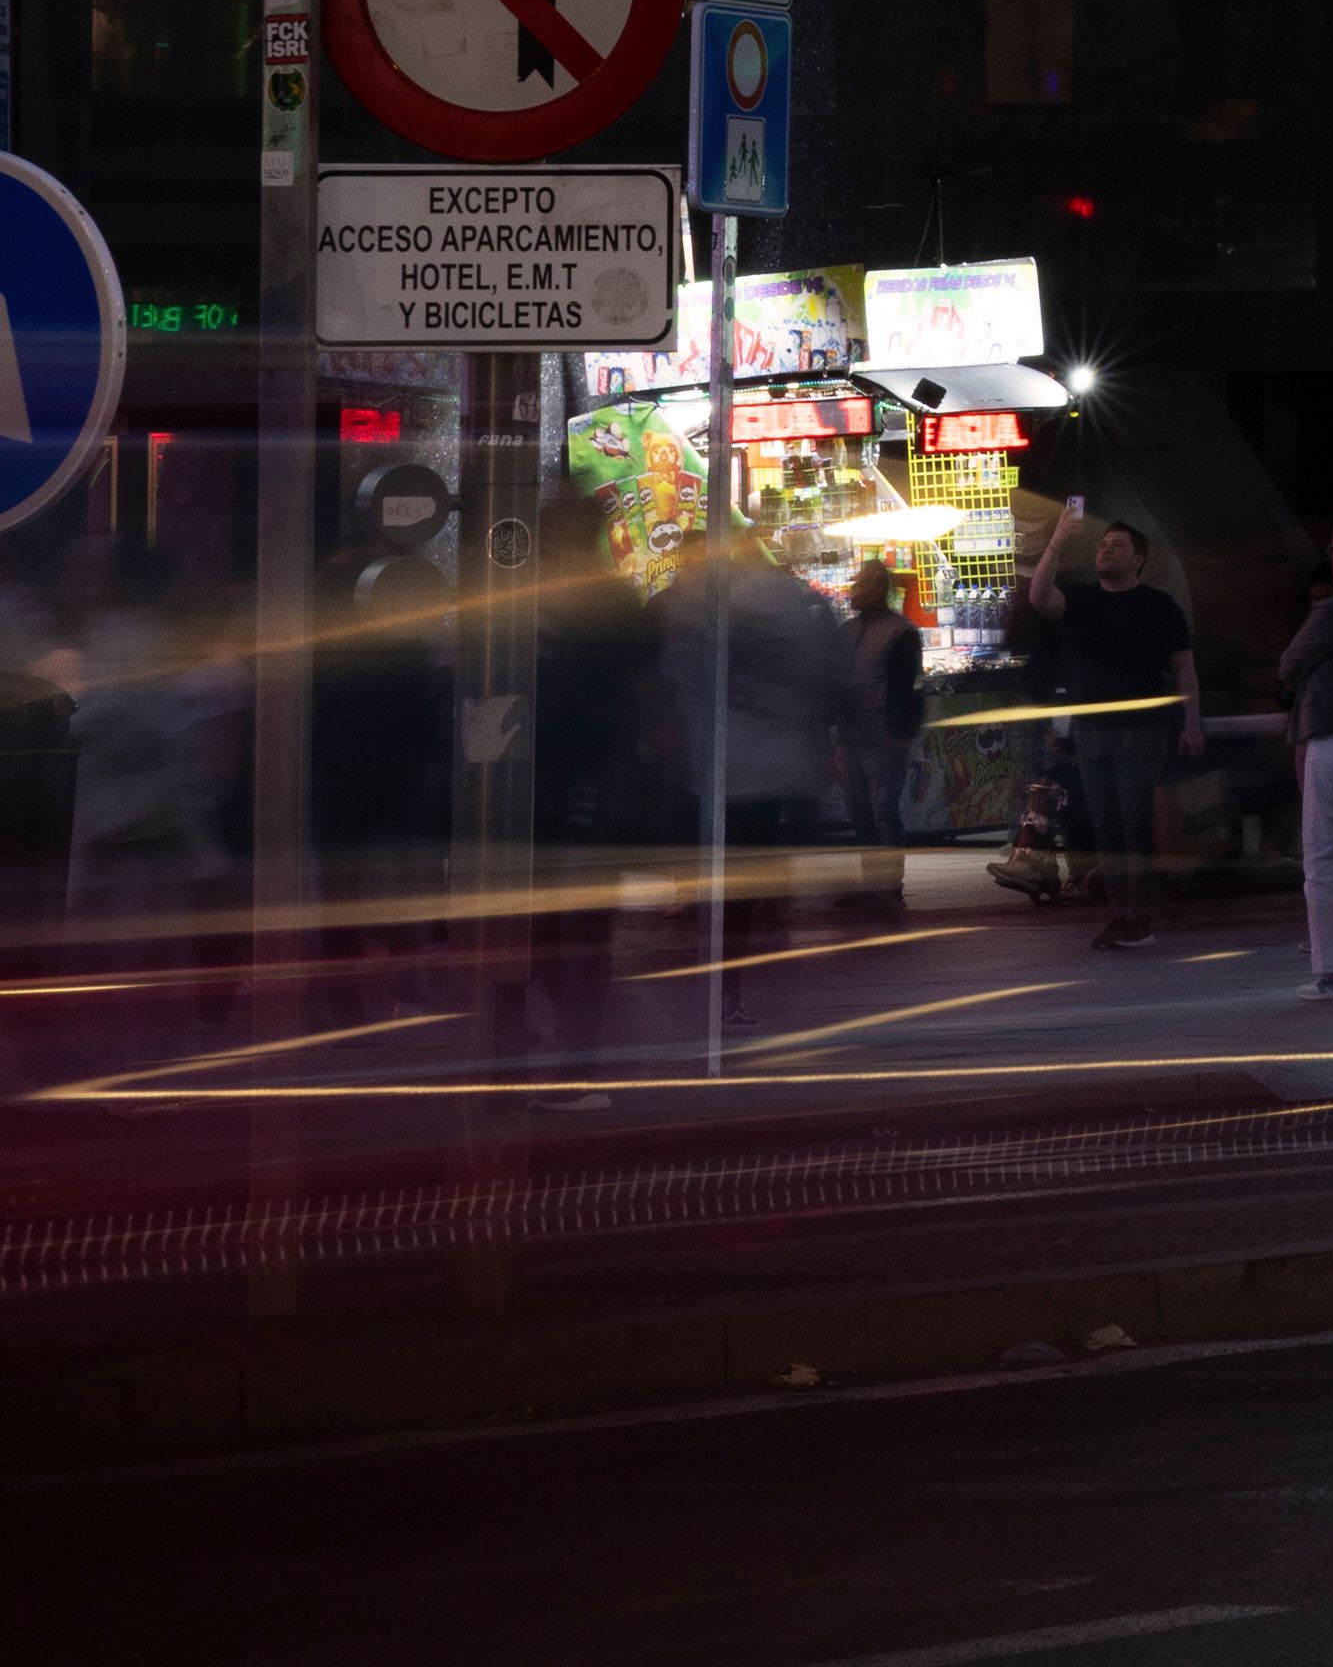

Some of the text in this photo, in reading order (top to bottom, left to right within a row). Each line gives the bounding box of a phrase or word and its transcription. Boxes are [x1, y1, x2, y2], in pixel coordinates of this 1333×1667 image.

[267, 21, 308, 41] FCK
[267, 39, 309, 58] ISRL
[429, 186, 556, 214] EXCEPTO
[318, 224, 664, 257] ACCESO APARCAMIENTO,
[401, 263, 578, 294] HOTEL, E.M.T
[399, 301, 583, 329] Y BICICLETAS
